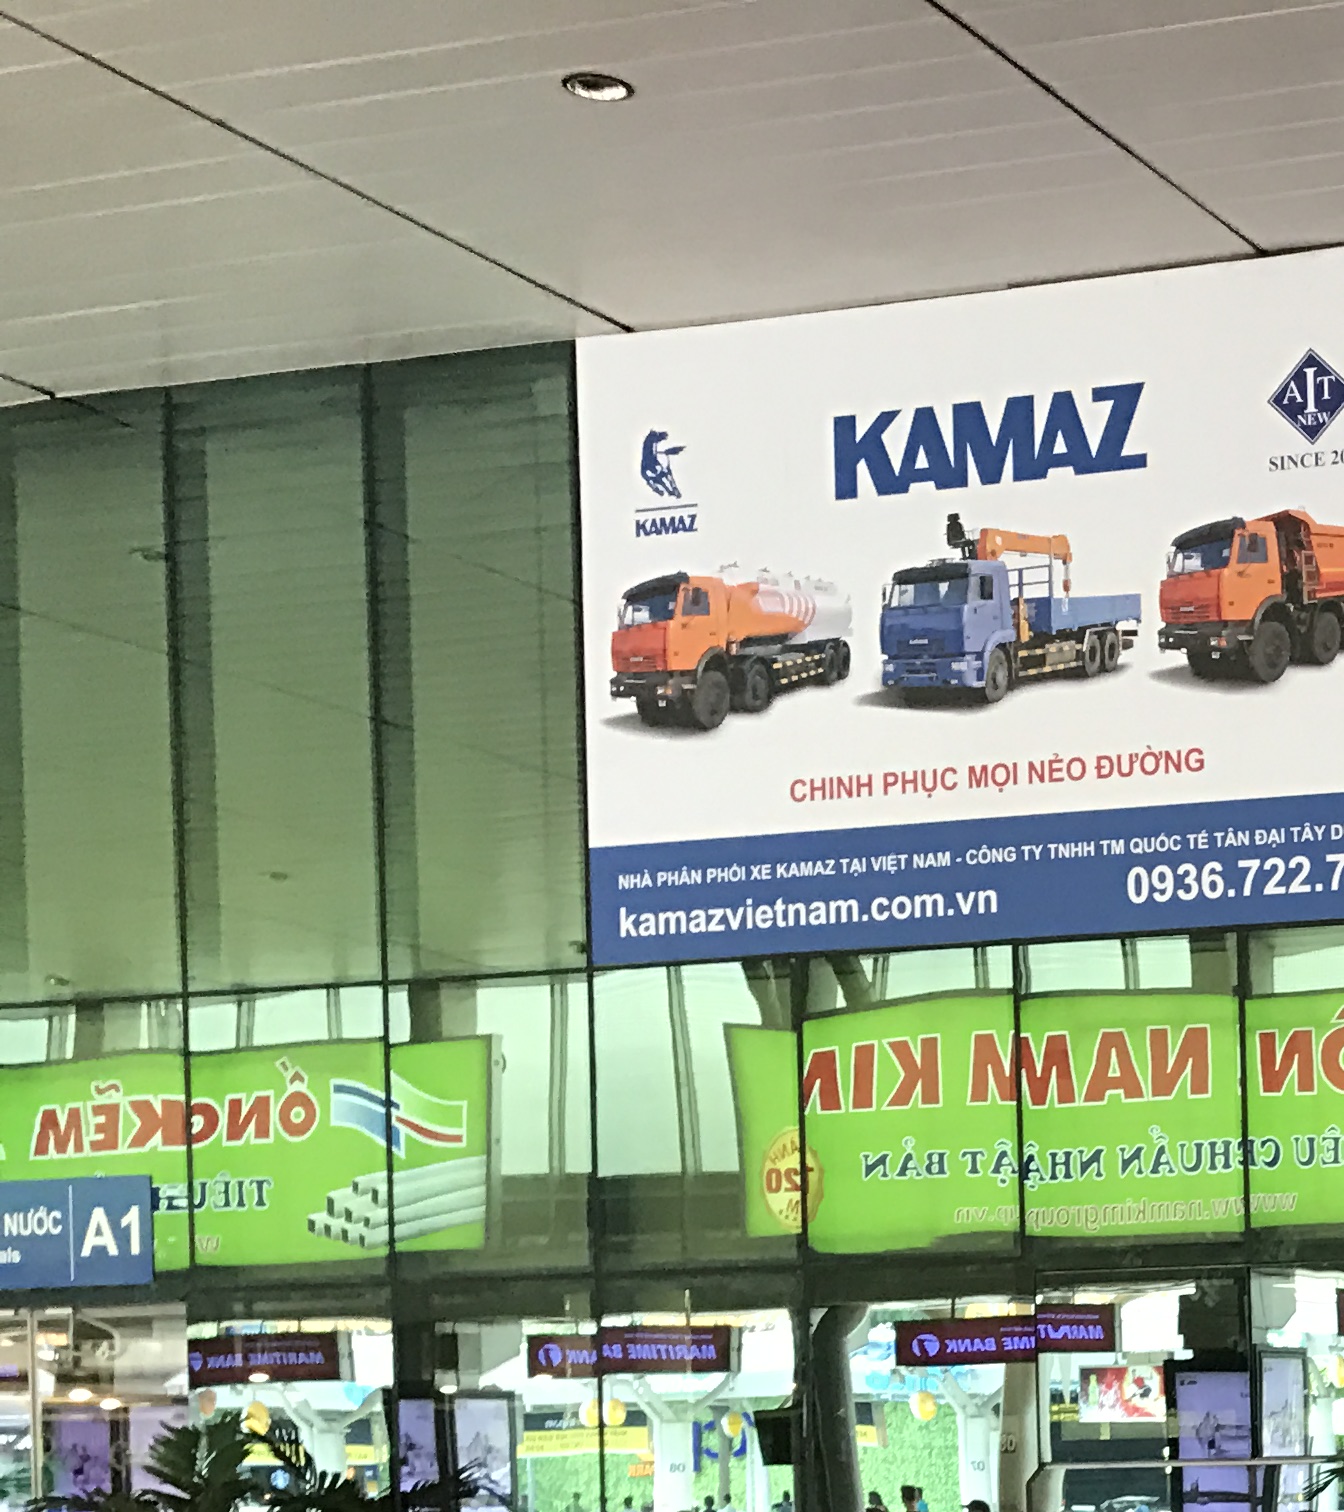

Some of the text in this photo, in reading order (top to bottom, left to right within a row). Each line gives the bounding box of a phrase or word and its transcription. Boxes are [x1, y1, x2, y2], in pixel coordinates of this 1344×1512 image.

[833, 382, 1147, 500] KAMAZ
[1297, 412, 1330, 426] NEW
[1268, 452, 1326, 472] SINCE
[634, 515, 698, 537] KAMAZ
[790, 746, 1205, 804] CHINH PHỤC MỌI NẺO ĐƯỜNG
[618, 868, 653, 890] NHÀ
[657, 867, 701, 887] PHÂN
[750, 864, 772, 881] XE
[776, 859, 836, 879] KAMAZ
[839, 857, 867, 878] TẠI
[870, 852, 908, 875] VIỆT
[912, 851, 951, 870] NAM
[966, 844, 1017, 866] CÔNG
[1021, 843, 1042, 861] TY
[1047, 840, 1095, 859] TNHH
[1099, 838, 1125, 856] TM
[1213, 827, 1249, 848] TÂN
[1254, 825, 1286, 849] ĐẠI
[1290, 821, 1326, 842] TÂY
[619, 888, 998, 939] kamazvietnam.com.vn
[3, 1205, 63, 1237] NƯỚC
[80, 1204, 141, 1258] A1
